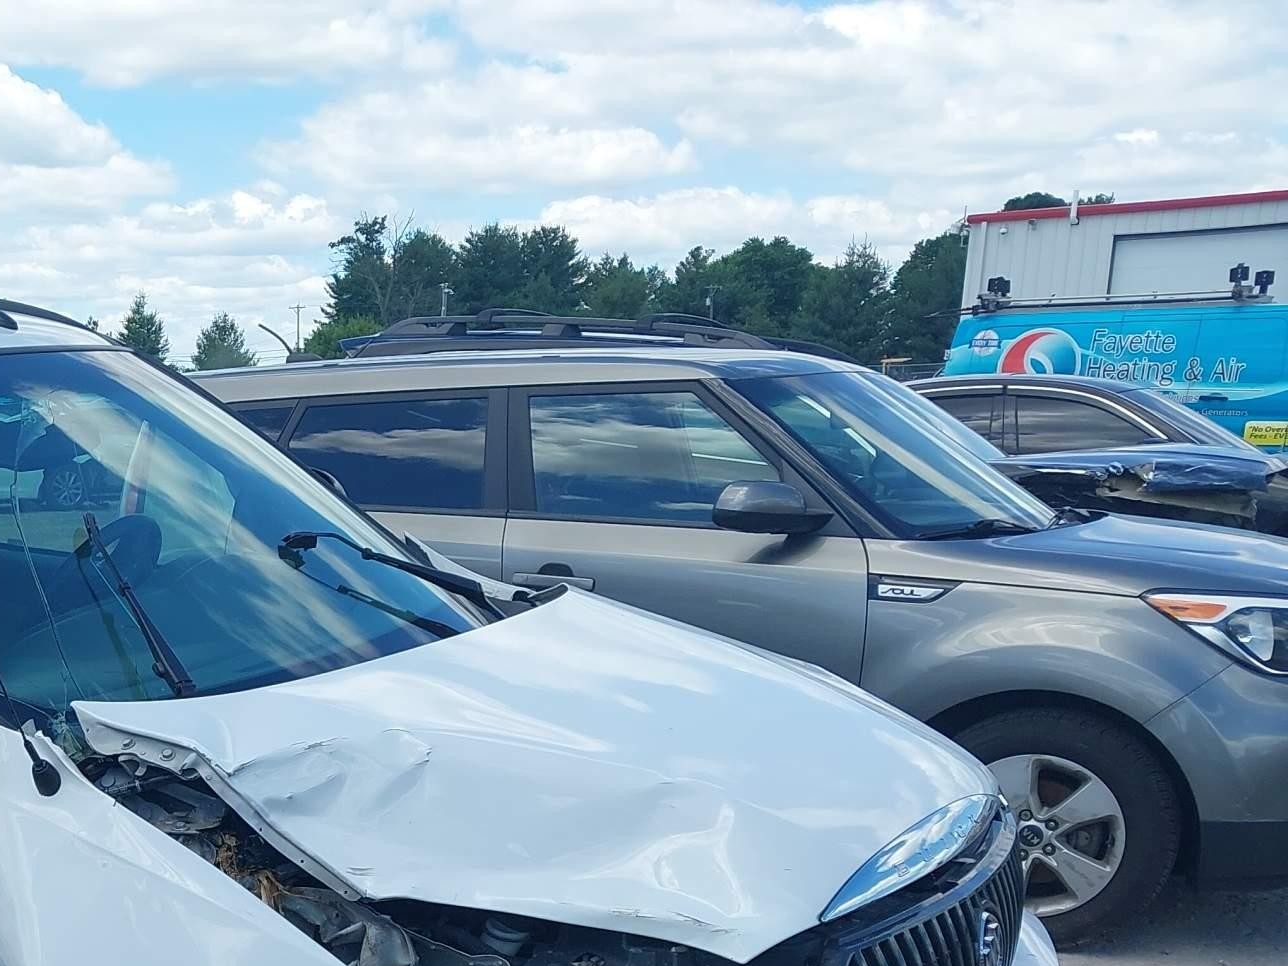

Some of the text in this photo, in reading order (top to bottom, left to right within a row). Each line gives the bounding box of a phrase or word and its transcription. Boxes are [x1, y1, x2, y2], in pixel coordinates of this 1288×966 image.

[1090, 329, 1177, 359] Fayette
[1086, 357, 1247, 387] Heating & Air
